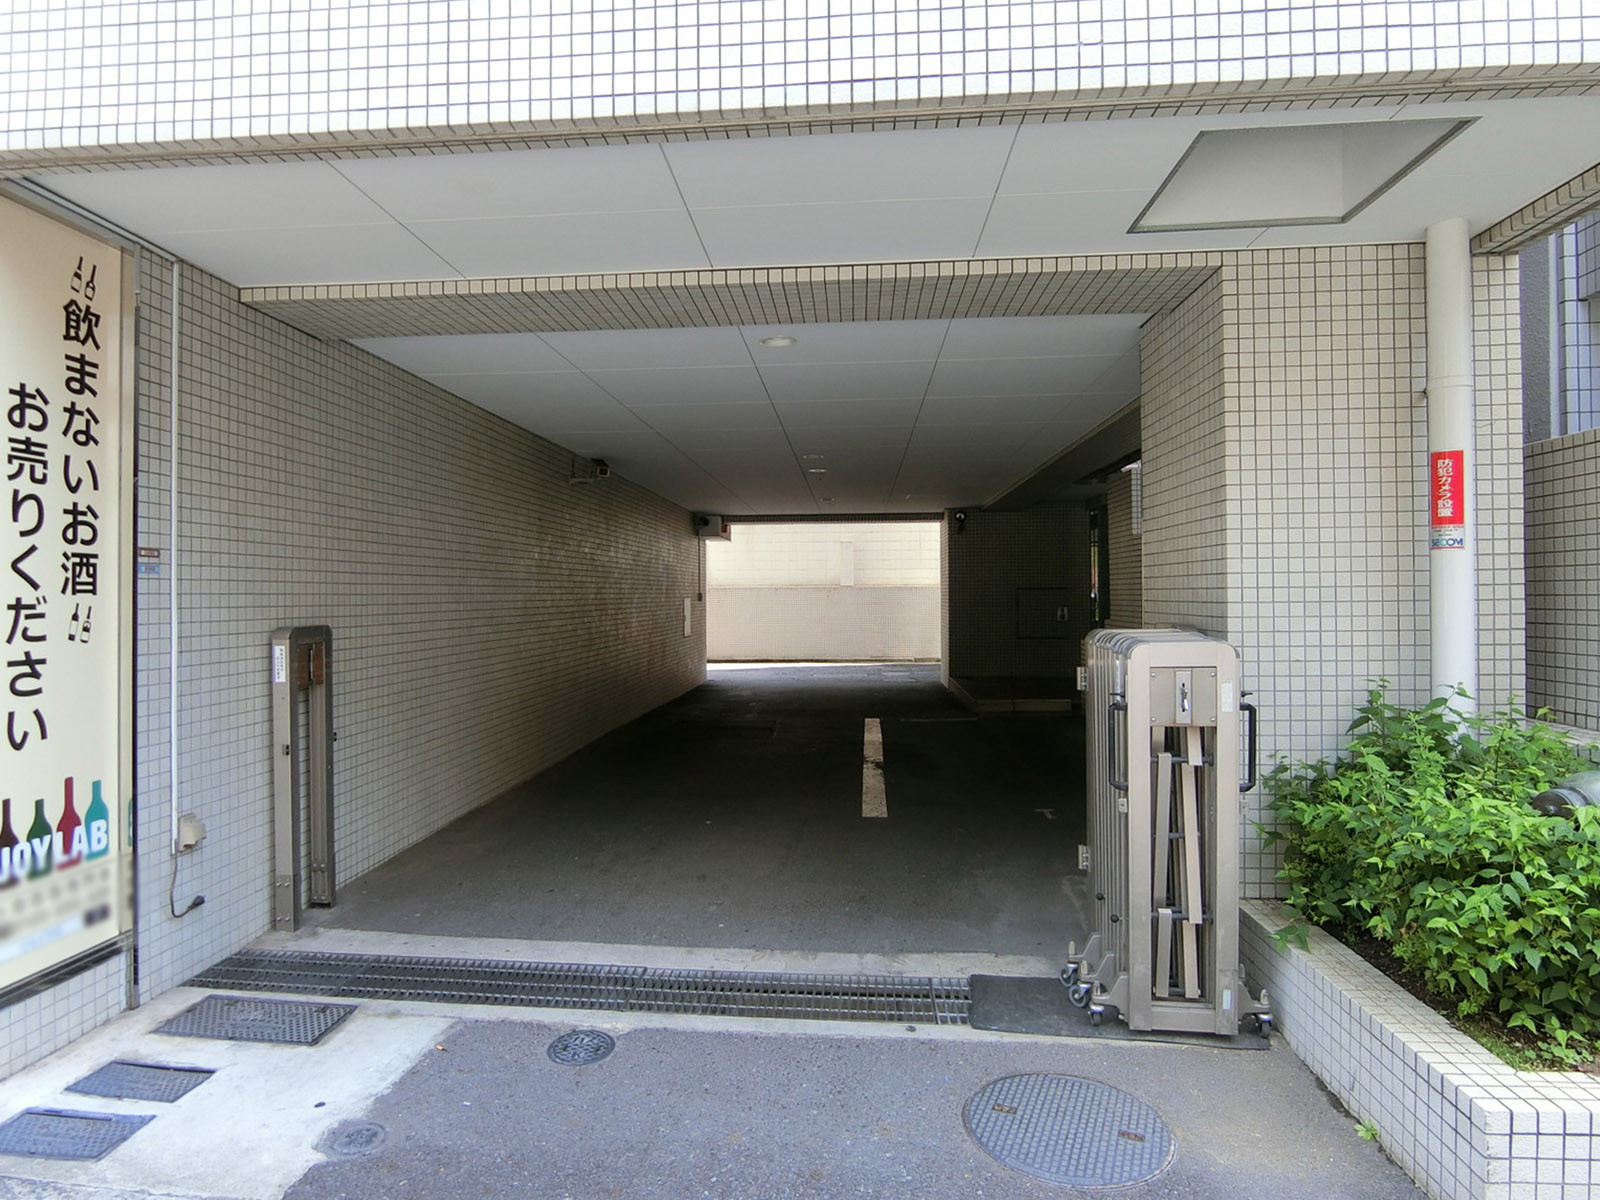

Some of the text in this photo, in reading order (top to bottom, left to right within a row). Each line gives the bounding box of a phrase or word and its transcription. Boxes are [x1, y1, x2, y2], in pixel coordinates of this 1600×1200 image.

[6, 382, 49, 752] お売りください
[60, 299, 101, 596] 飲まないお酒
